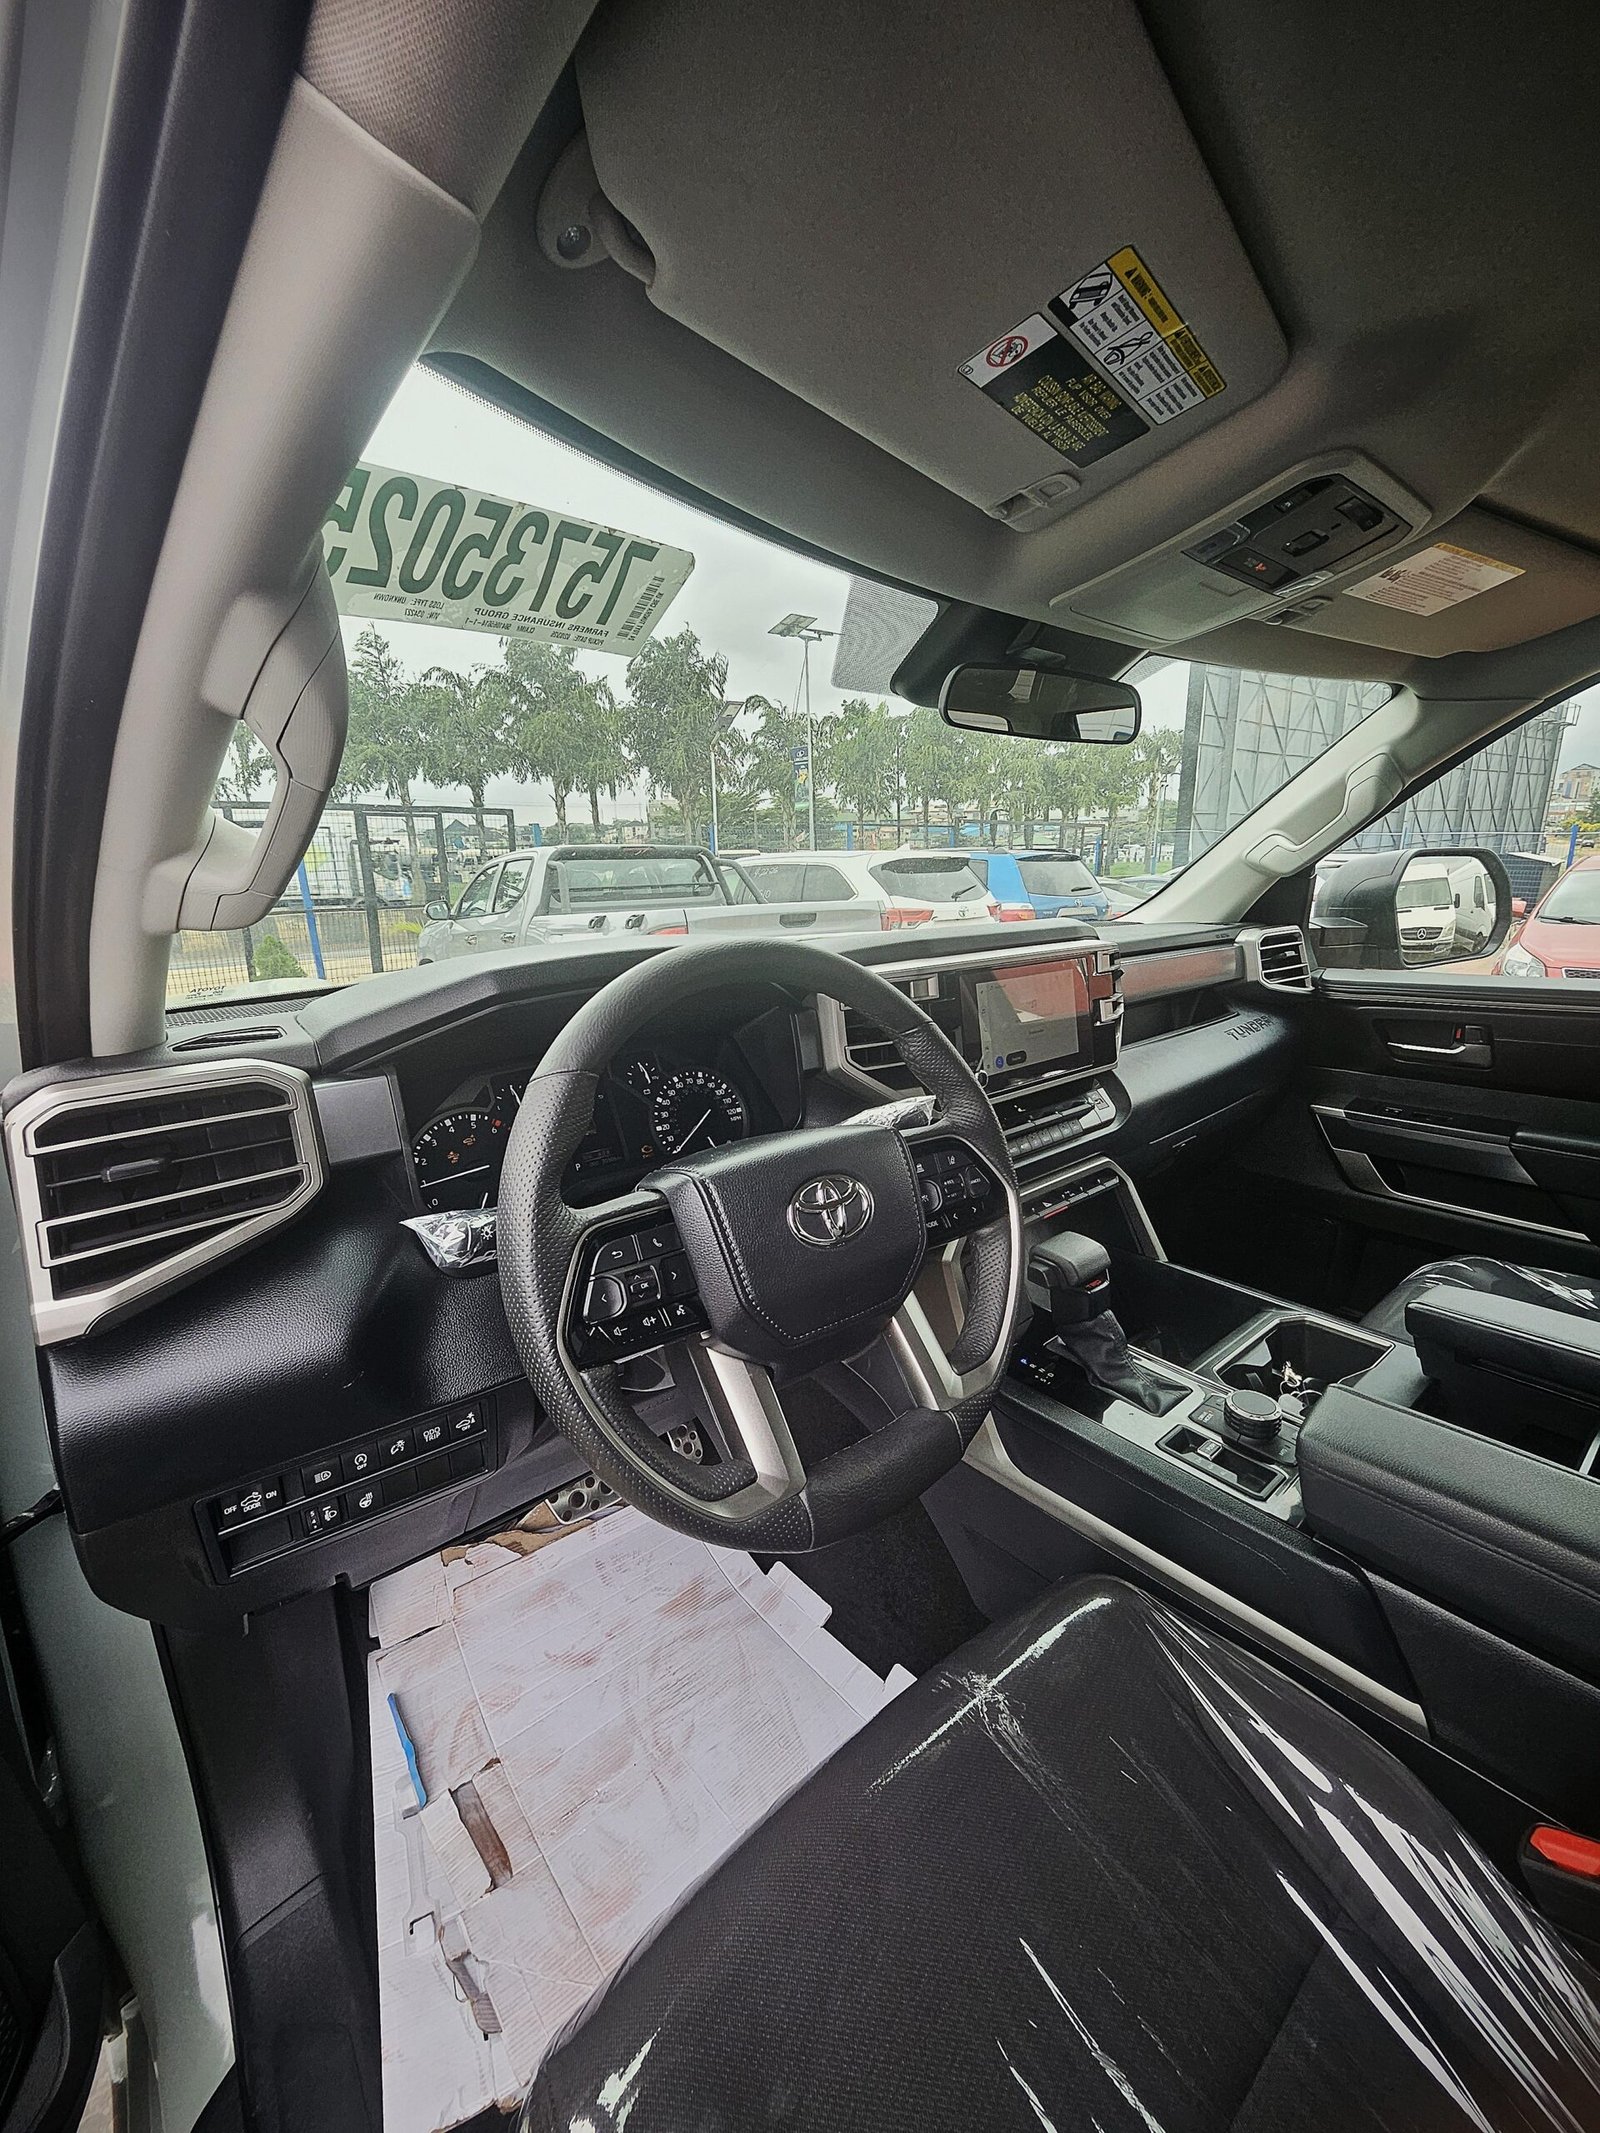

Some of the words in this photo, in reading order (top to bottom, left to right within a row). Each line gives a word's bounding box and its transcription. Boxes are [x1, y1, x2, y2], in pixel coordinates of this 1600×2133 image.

[1223, 1015, 1275, 1041] TUNDRA
[668, 1089, 676, 1097] 50
[421, 1158, 428, 1166] 2
[575, 1163, 581, 1171] P
[423, 1426, 440, 1438] ODO
[424, 1432, 441, 1442] TRIP
[224, 1505, 237, 1515] OFF
[265, 1490, 277, 1499] ON
[243, 1502, 261, 1512] DOOR
